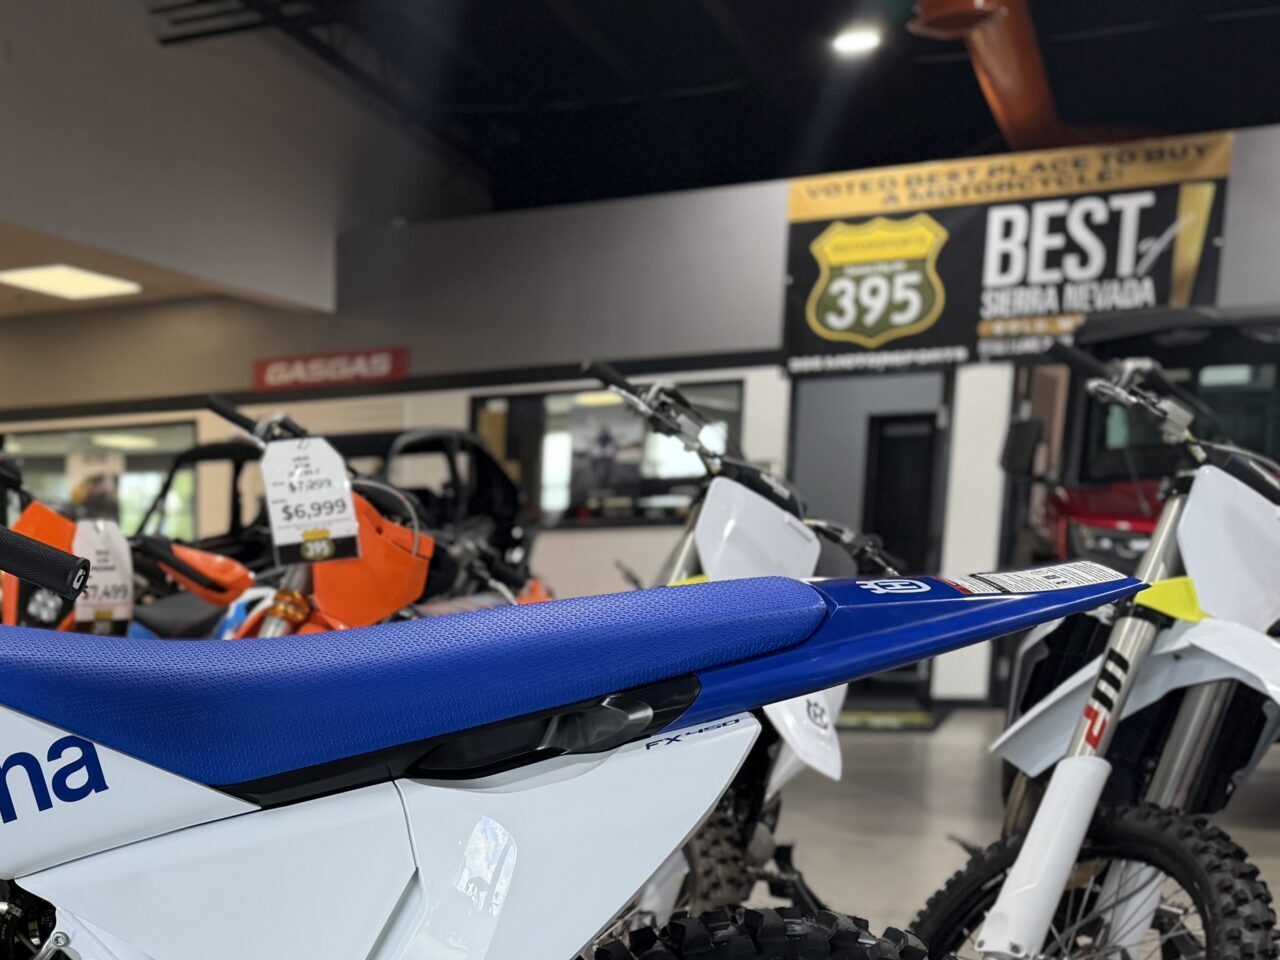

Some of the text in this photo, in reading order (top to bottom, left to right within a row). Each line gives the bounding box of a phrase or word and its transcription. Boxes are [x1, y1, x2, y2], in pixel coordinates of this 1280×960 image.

[982, 191, 1156, 288] BEST
[824, 271, 924, 330] 395
[979, 275, 1157, 319] SIERRA NEVADA
[263, 352, 394, 386] GASGAS
[282, 498, 347, 522] $6,999
